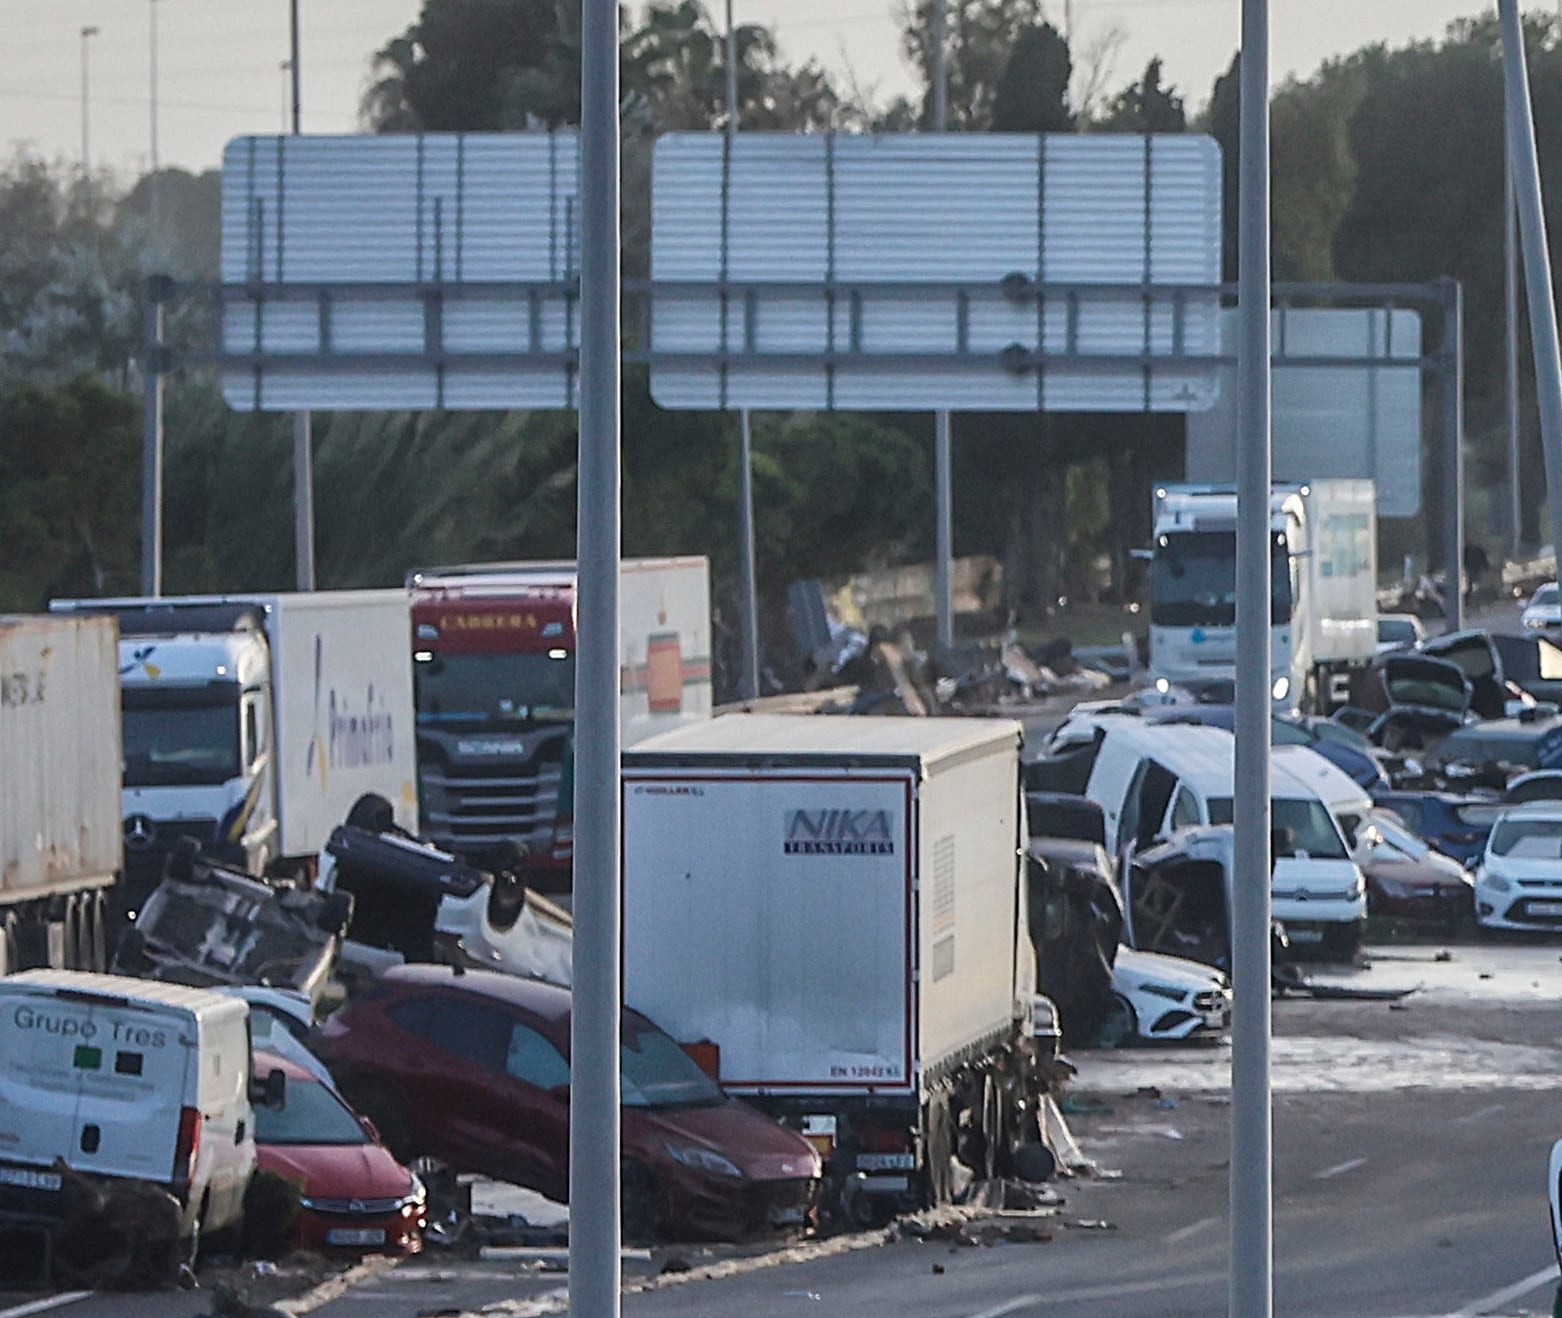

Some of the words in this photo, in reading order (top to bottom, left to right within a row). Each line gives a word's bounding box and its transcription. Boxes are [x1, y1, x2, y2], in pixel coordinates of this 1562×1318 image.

[788, 809, 890, 839] NIKA
[14, 1006, 98, 1038] Grupo
[109, 1020, 166, 1048] Tres
